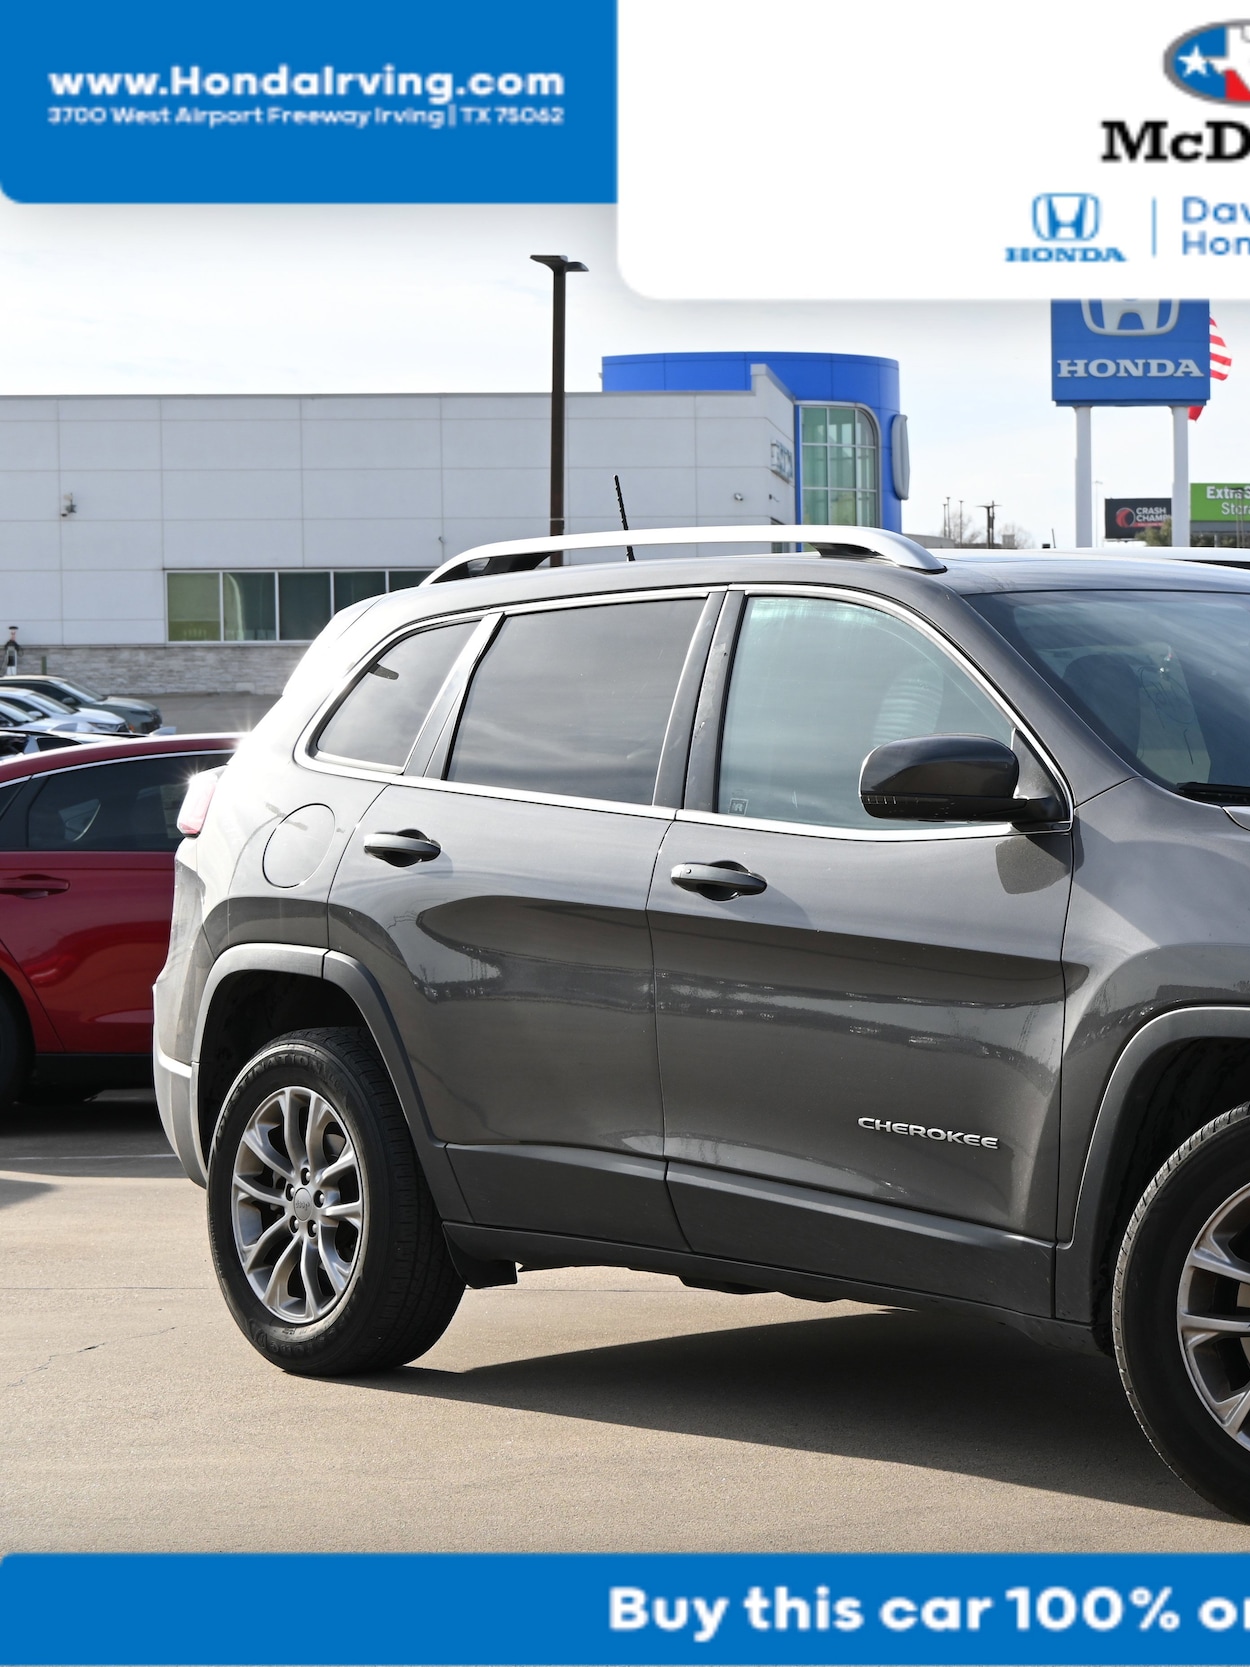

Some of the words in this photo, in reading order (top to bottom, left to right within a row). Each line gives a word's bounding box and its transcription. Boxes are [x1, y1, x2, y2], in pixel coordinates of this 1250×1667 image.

[1057, 358, 1204, 378] HONDA
[1136, 507, 1167, 515] CRASH
[1136, 514, 1170, 522] CHAMP
[857, 1117, 999, 1149] CHEROKEE
